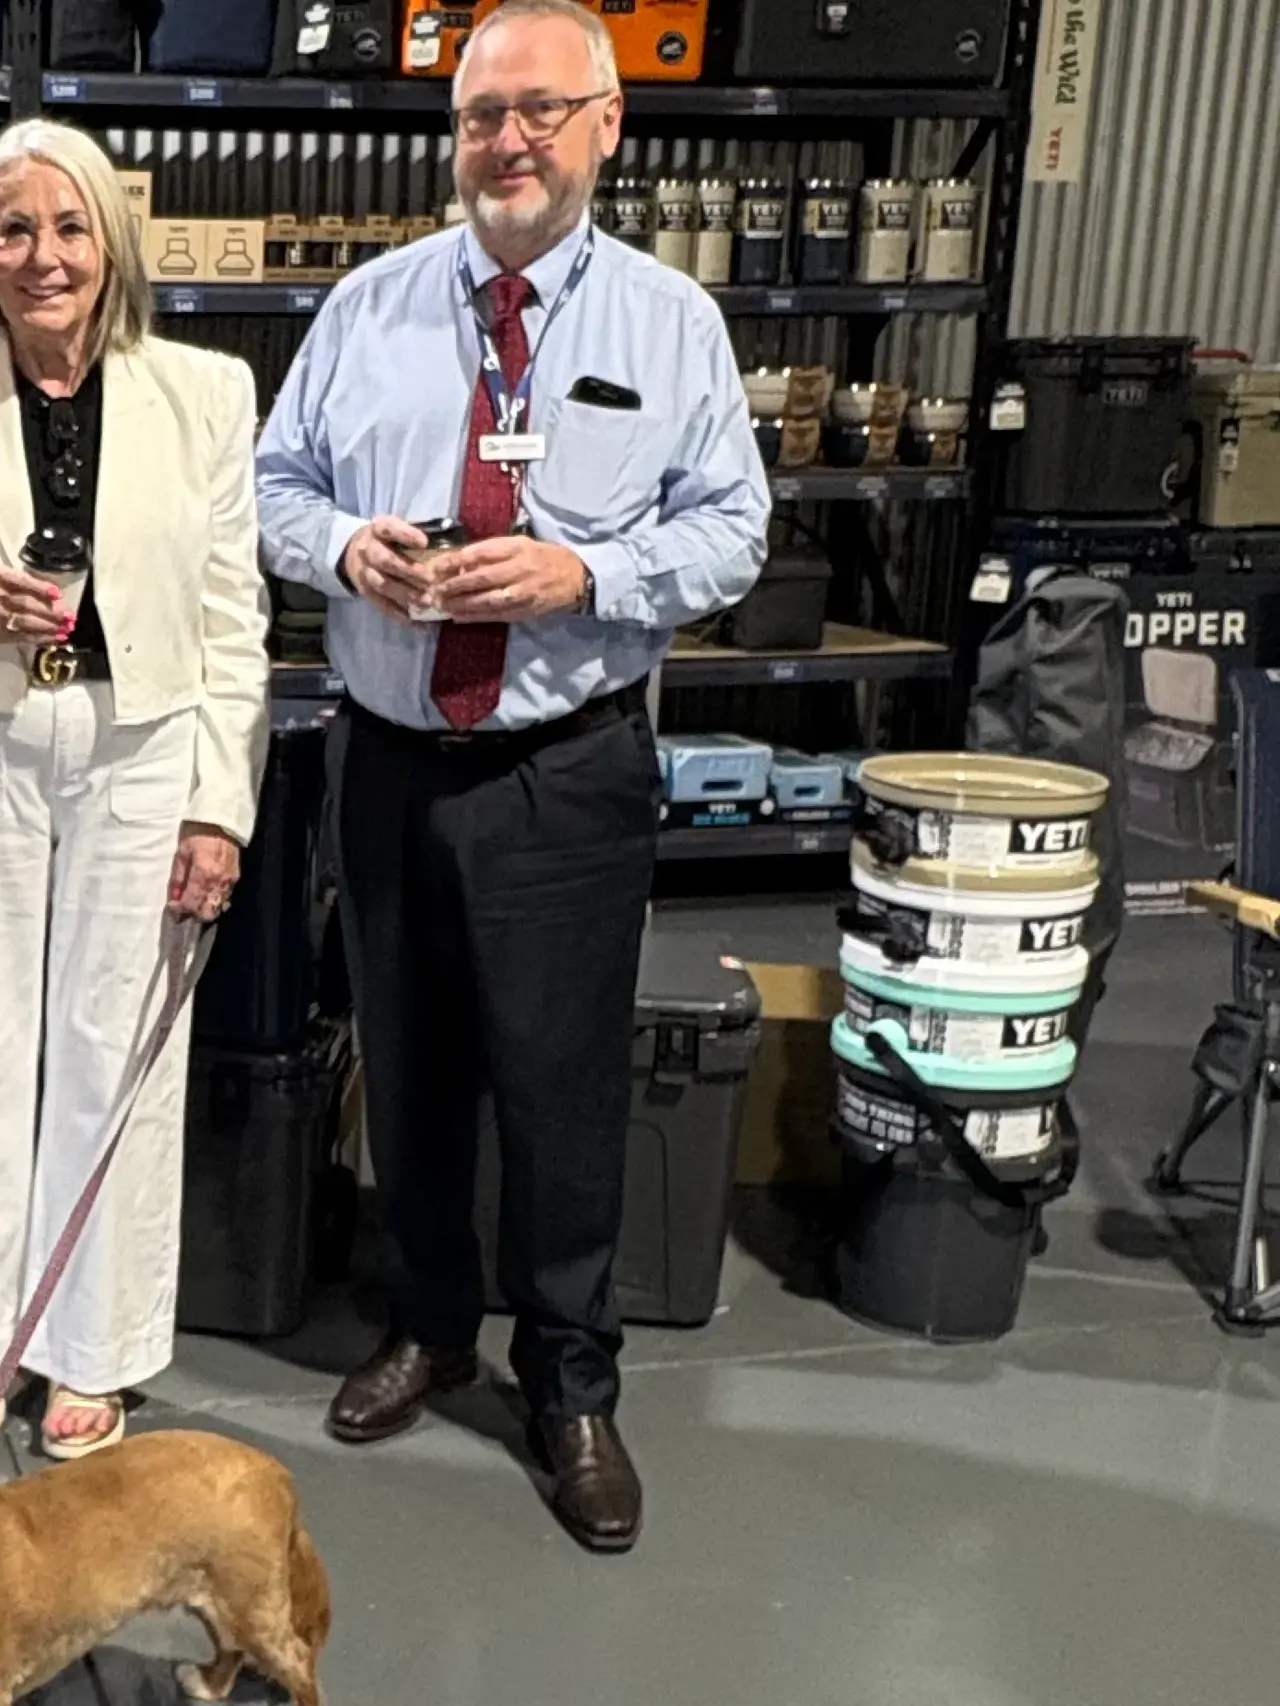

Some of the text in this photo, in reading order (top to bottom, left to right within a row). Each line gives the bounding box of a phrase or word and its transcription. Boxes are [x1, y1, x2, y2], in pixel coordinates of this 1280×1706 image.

[1156, 592, 1193, 608] YETI
[1018, 820, 1089, 852] YETI
[1028, 915, 1083, 951] YET
